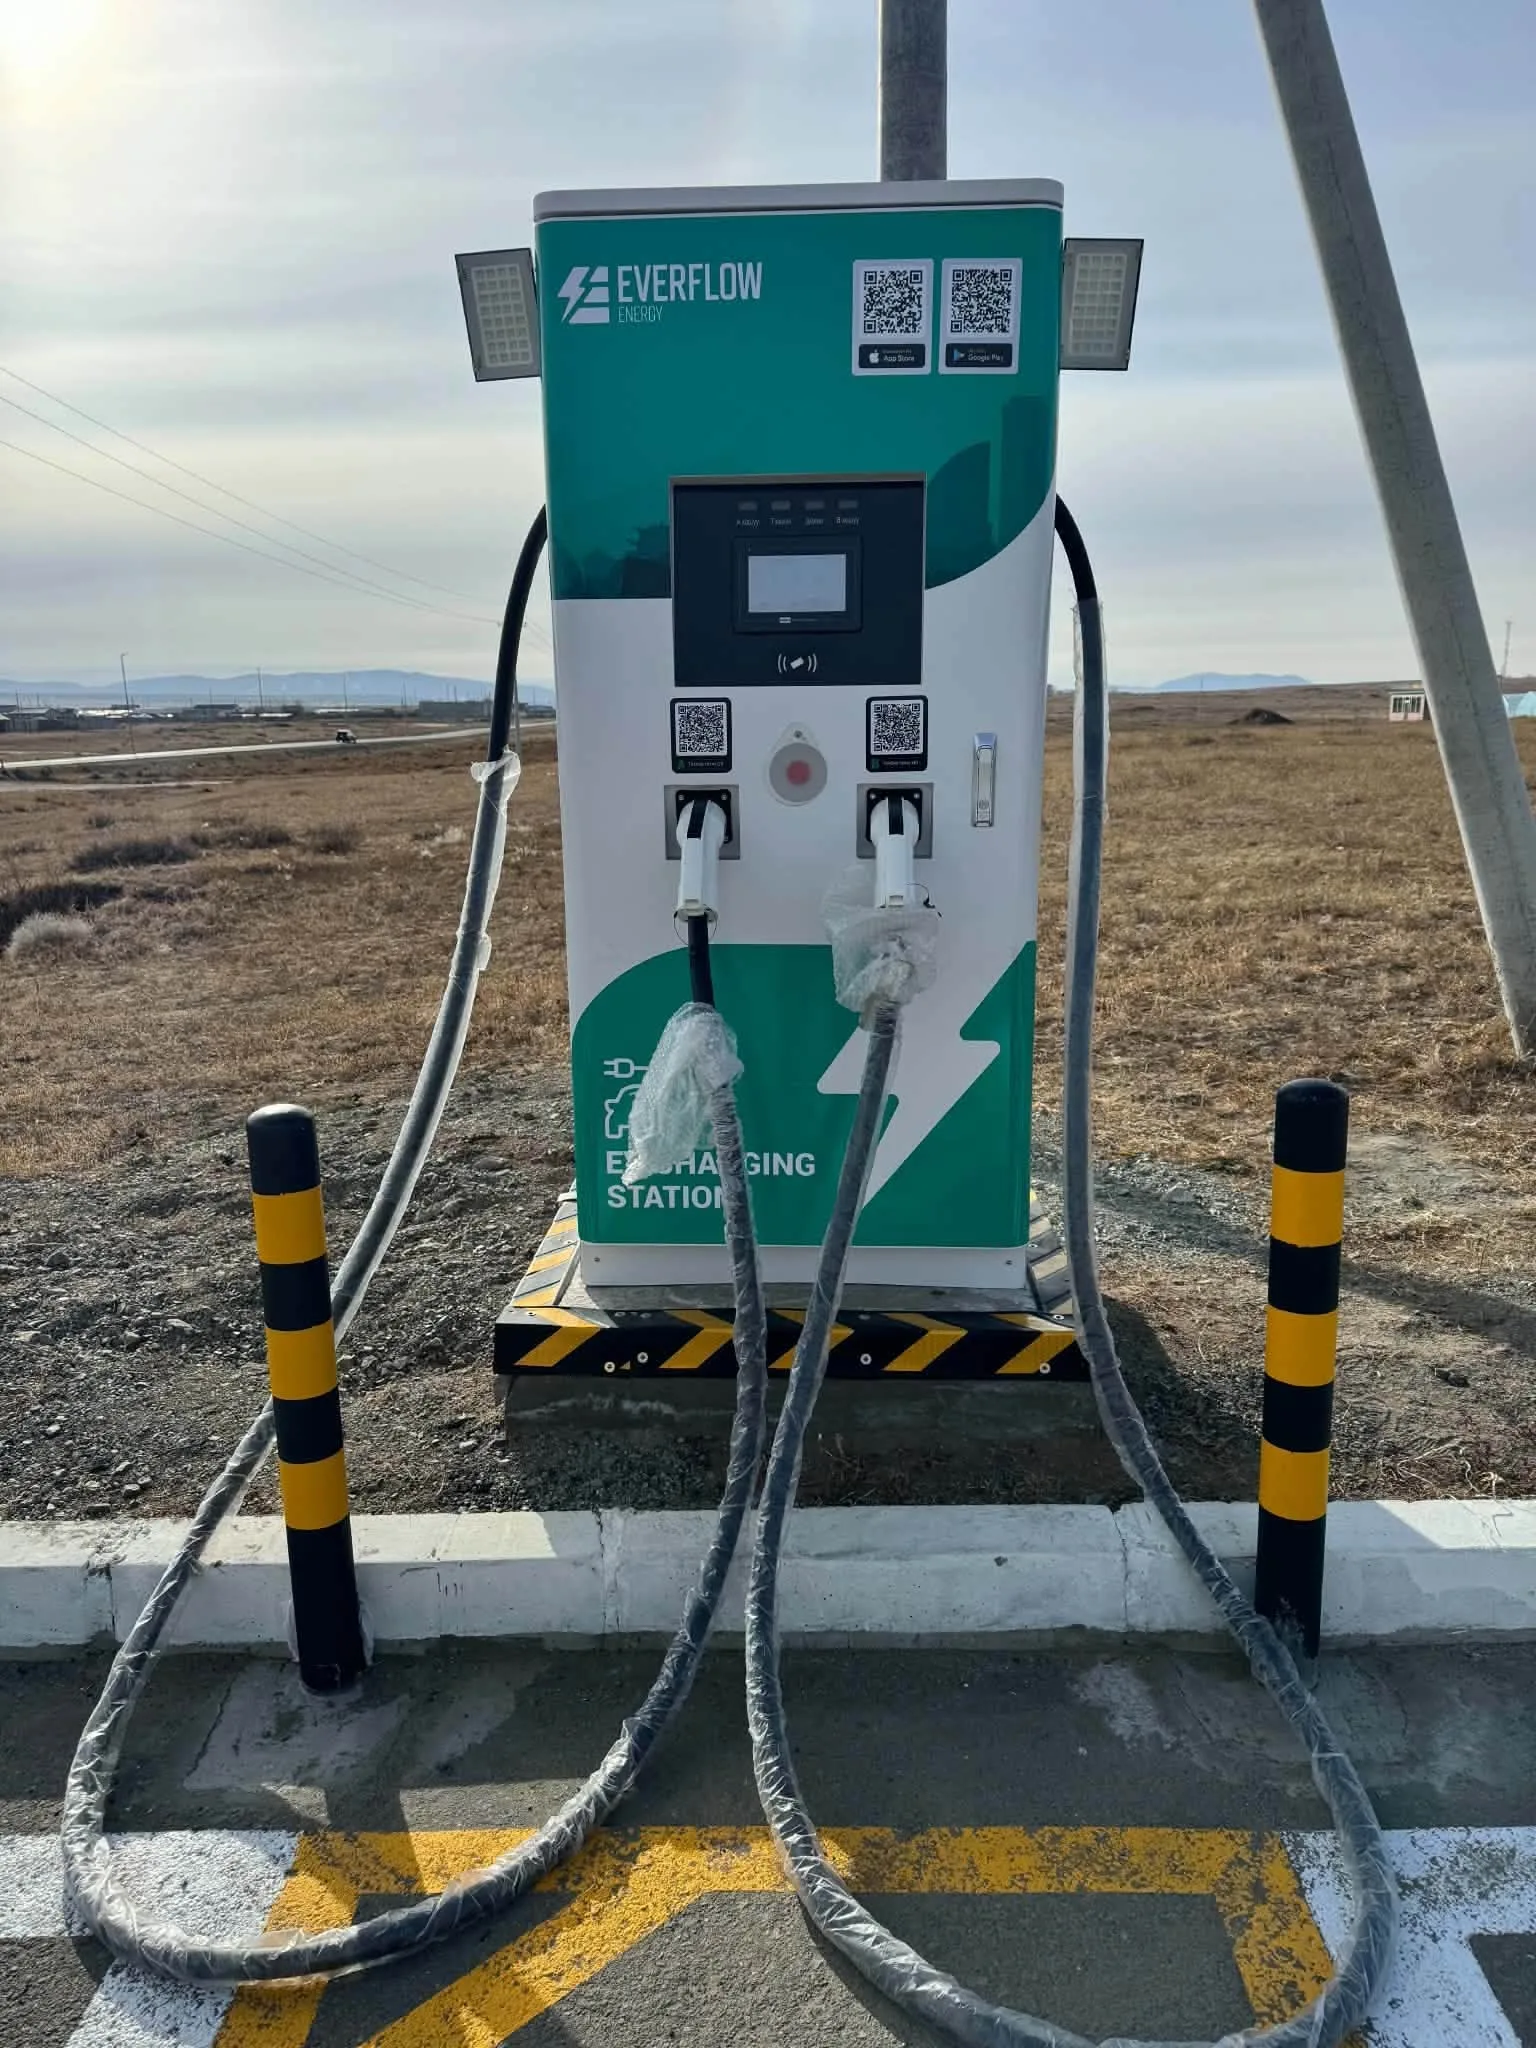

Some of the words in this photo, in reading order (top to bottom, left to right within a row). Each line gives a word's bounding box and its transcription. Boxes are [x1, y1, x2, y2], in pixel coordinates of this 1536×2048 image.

[617, 262, 763, 303] EVERFLOW
[618, 305, 663, 323] ENERGY
[968, 353, 990, 363] Google
